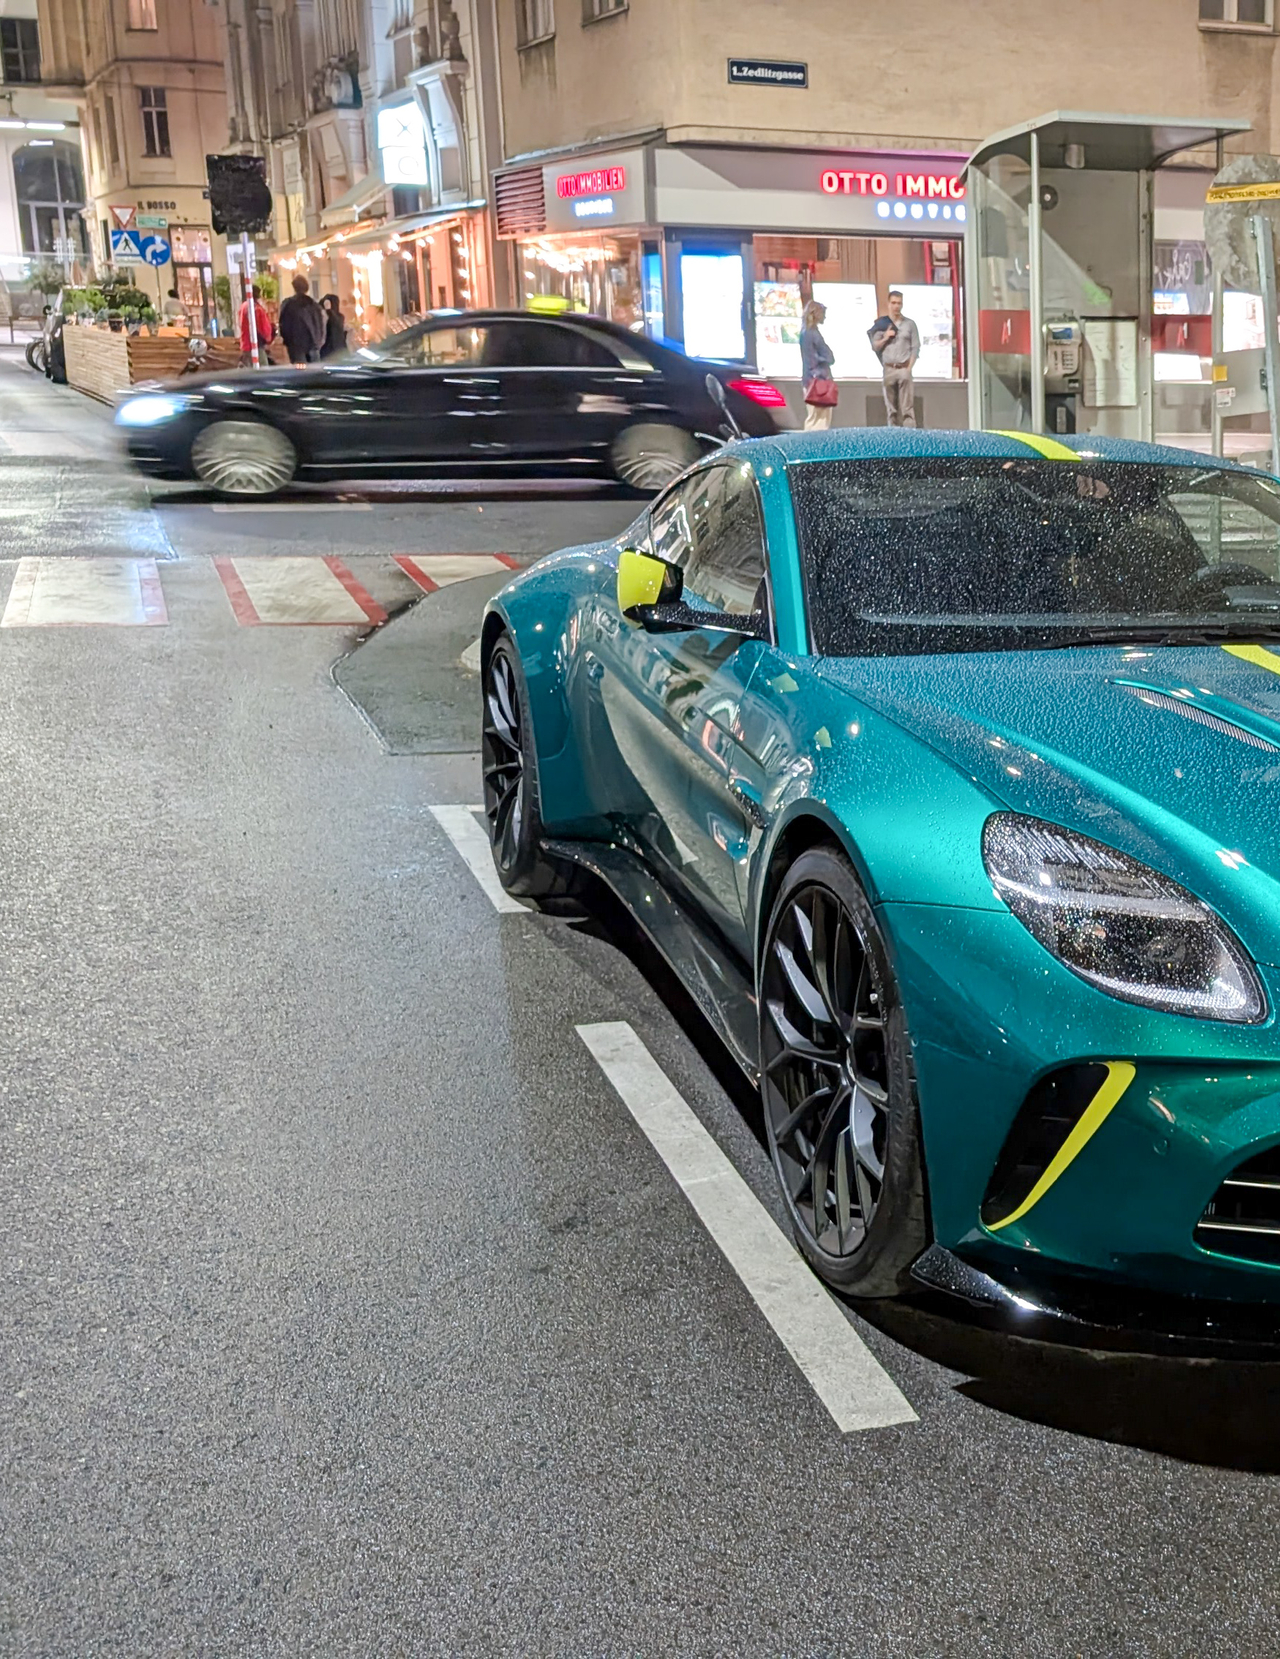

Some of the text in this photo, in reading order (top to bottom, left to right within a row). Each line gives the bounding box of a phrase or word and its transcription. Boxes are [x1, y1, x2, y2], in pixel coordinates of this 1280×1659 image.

[742, 67, 804, 80] Zedlitzgasse
[558, 168, 624, 198] OTTO IMMOBILIEN
[822, 171, 888, 195] OTTO
